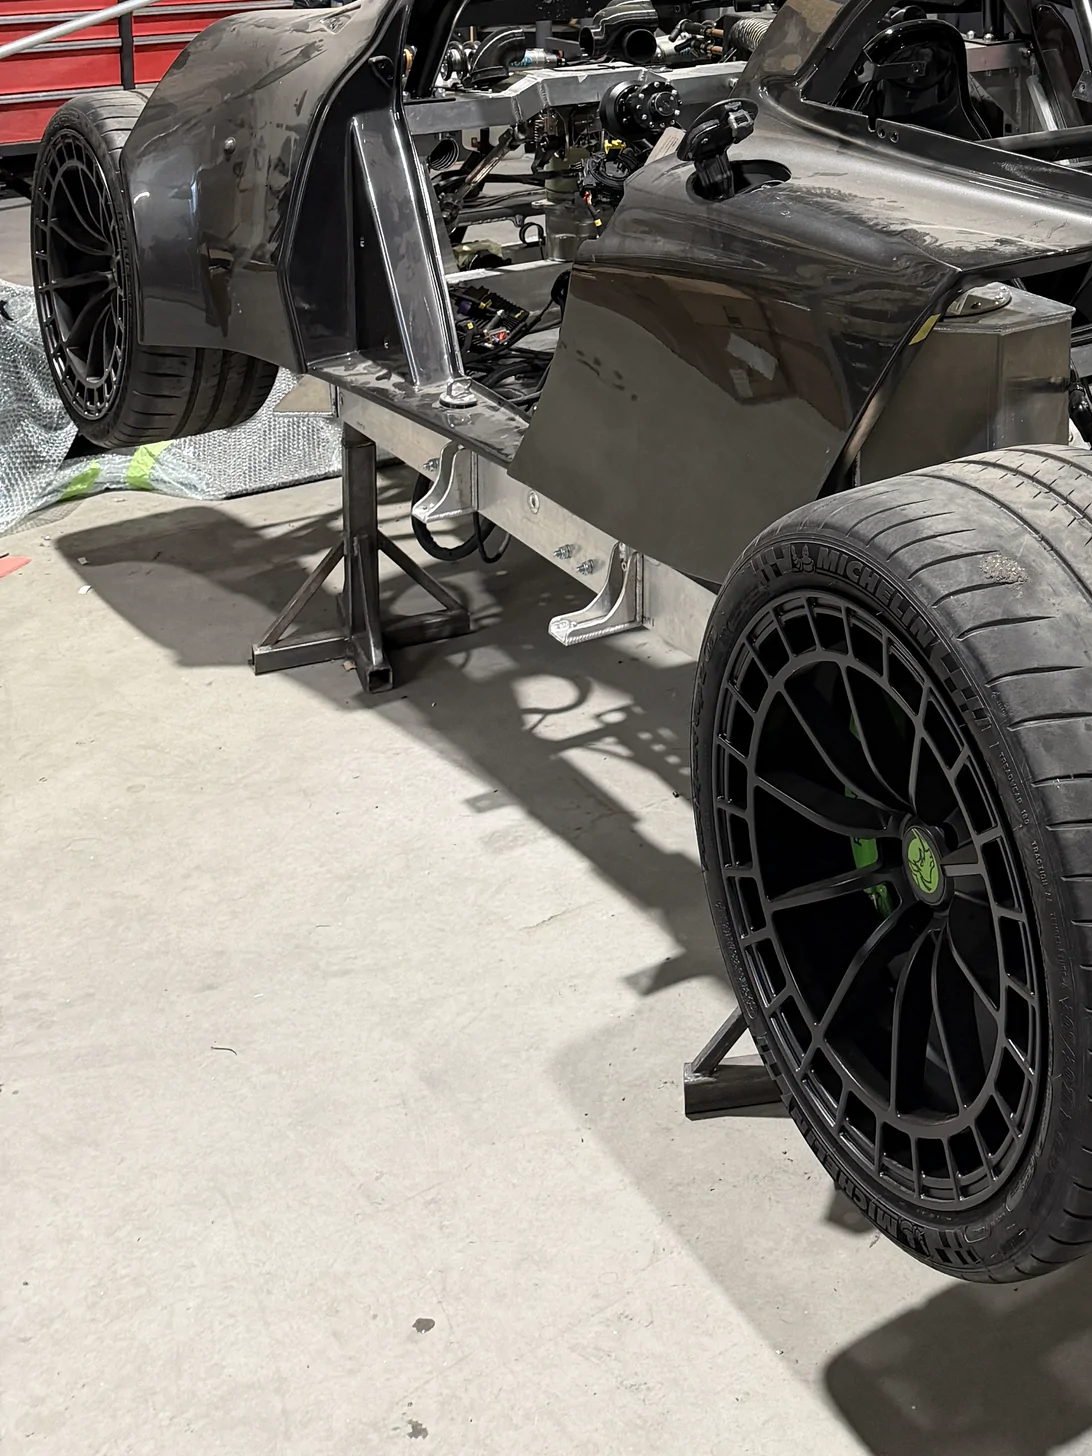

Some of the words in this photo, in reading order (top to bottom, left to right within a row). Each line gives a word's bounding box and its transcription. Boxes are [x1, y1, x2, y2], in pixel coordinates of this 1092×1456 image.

[816, 546, 938, 649] MICHELIN
[999, 751, 1023, 805] TREADWEAR
[1031, 840, 1049, 887] TRACTION
[789, 1106, 899, 1243] MICHELIN
